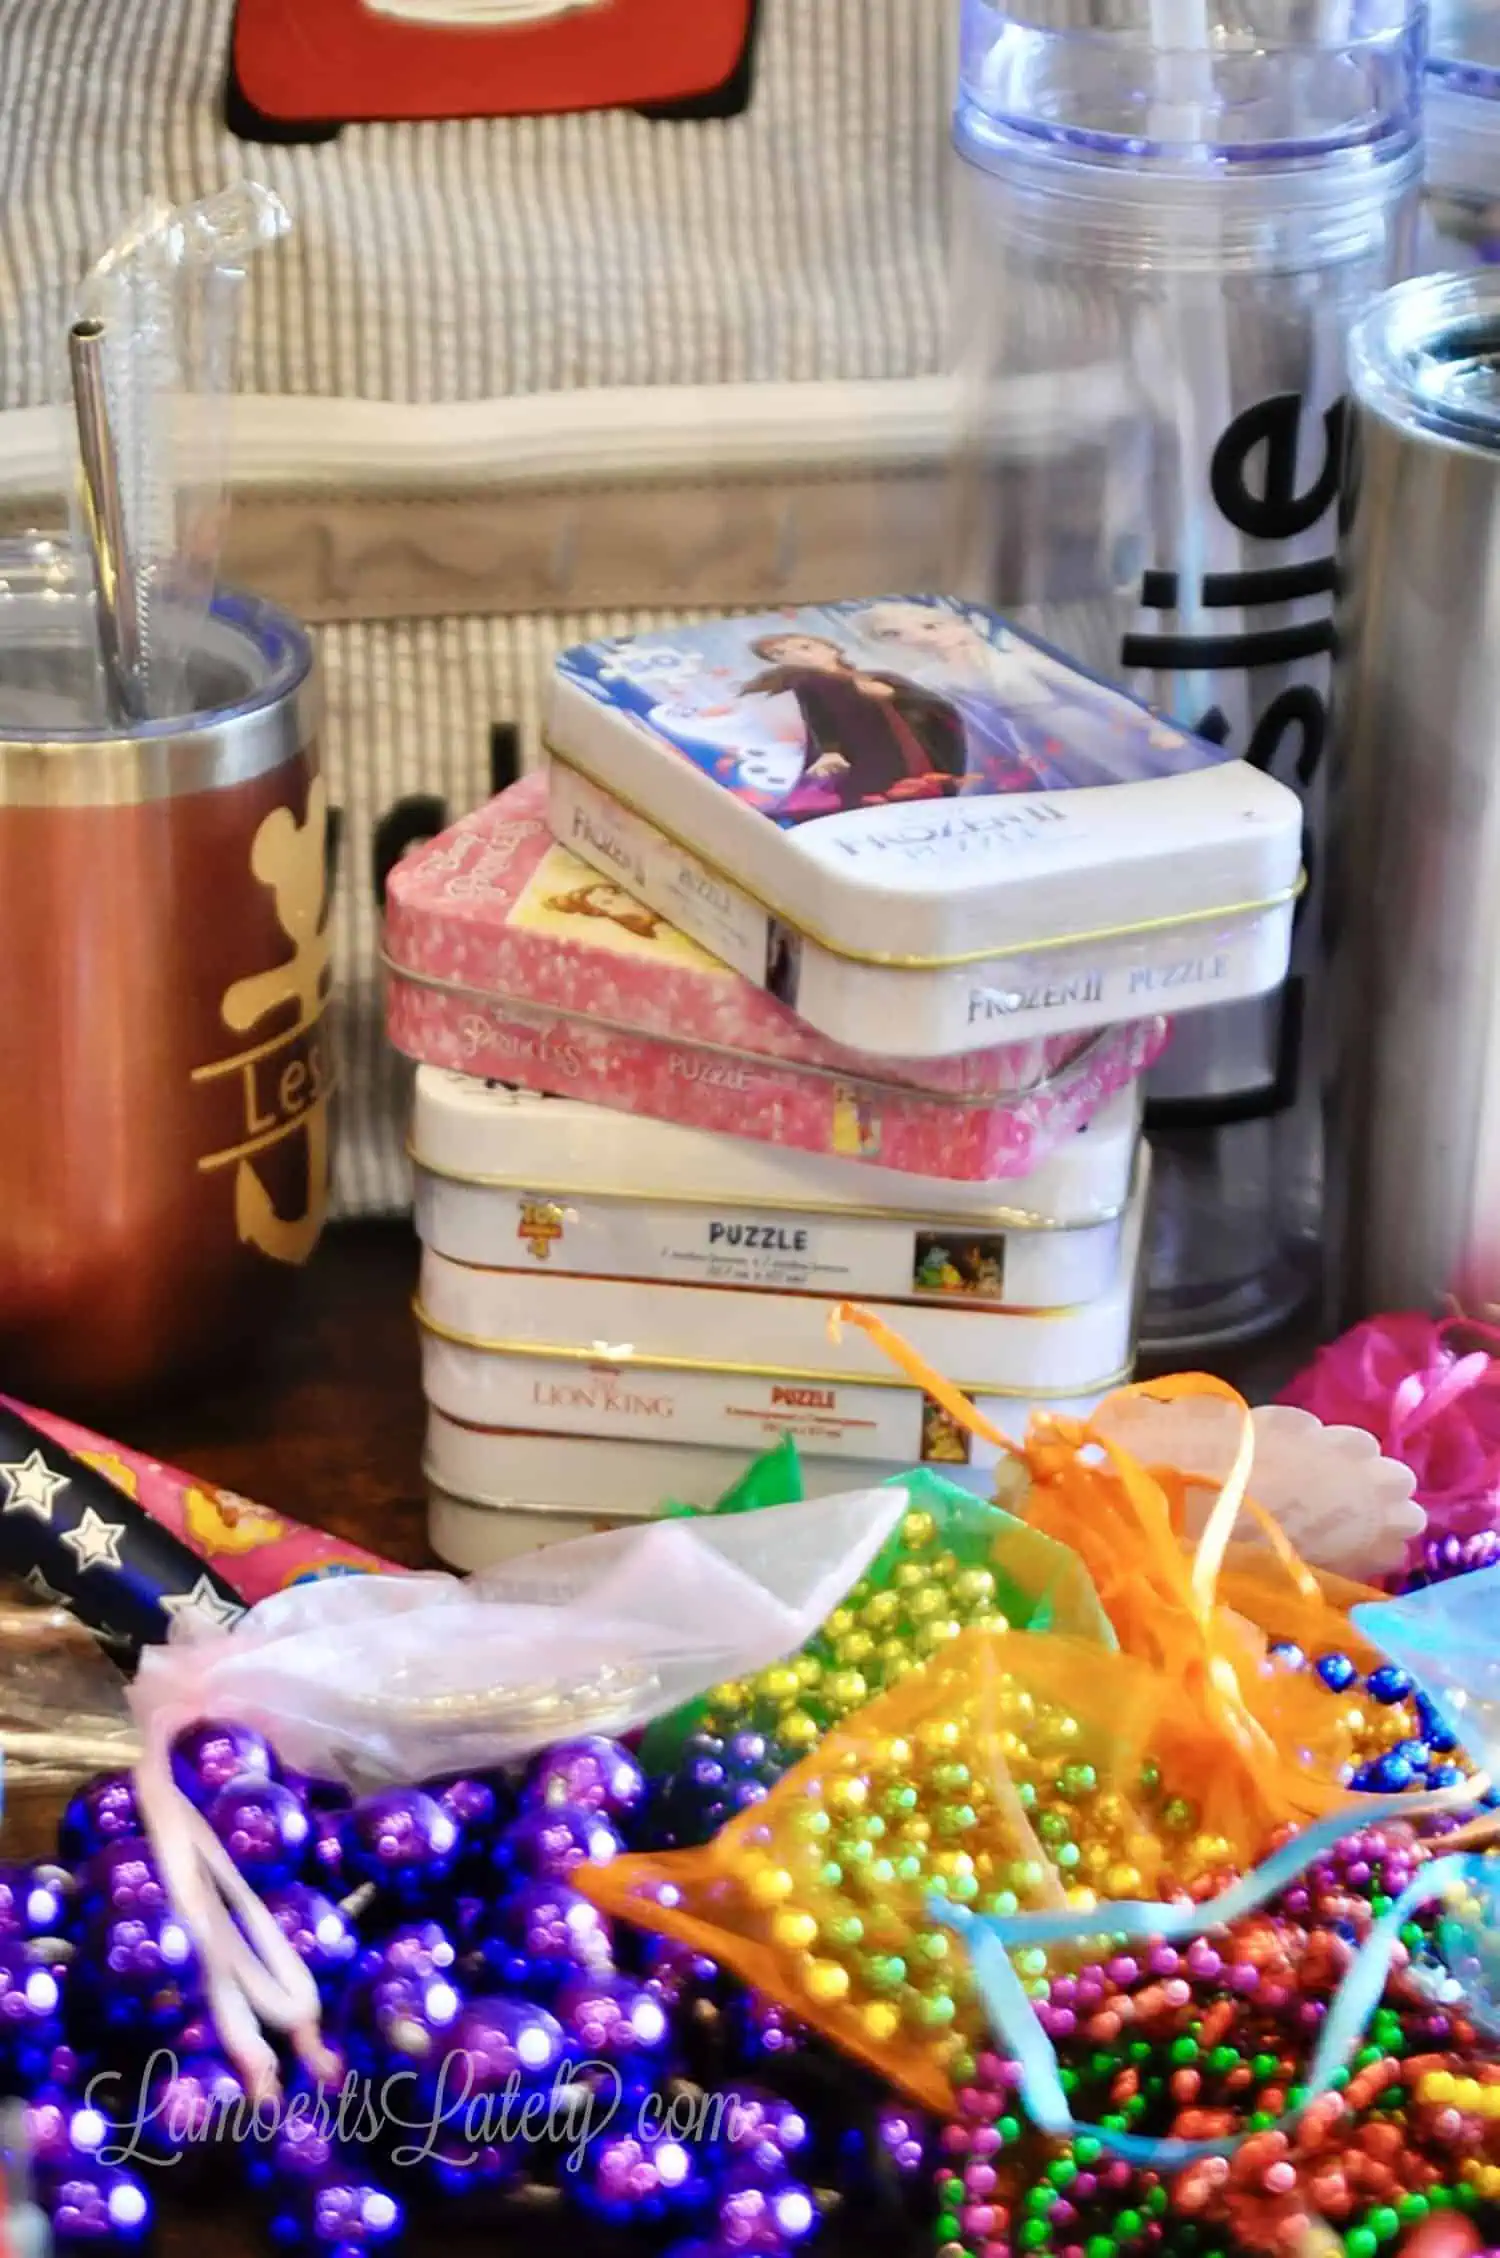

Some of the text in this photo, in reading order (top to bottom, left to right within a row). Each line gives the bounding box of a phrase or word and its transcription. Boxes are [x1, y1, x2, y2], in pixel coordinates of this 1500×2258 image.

[1122, 393, 1346, 1130] Lslie
[708, 1221, 808, 1251] PUZZLE
[533, 1380, 675, 1419] LION KING
